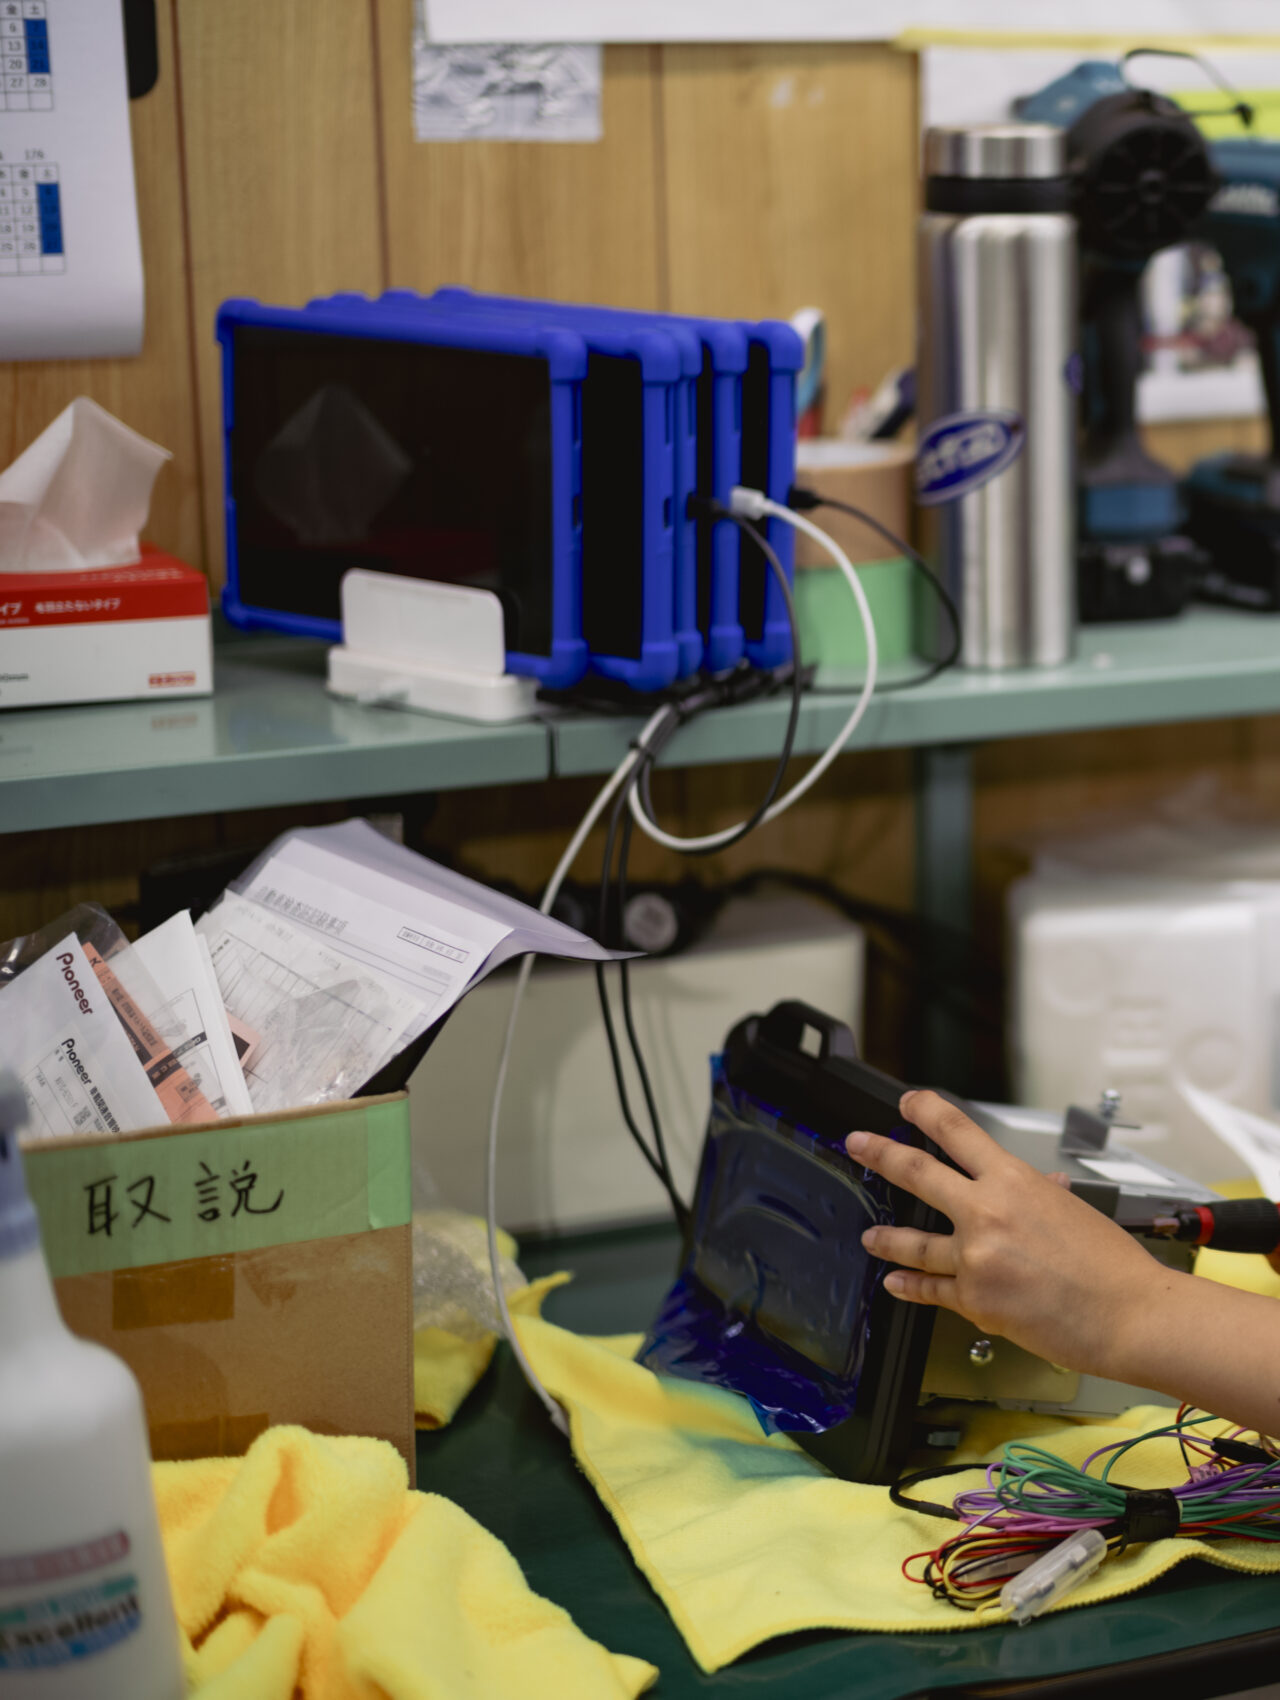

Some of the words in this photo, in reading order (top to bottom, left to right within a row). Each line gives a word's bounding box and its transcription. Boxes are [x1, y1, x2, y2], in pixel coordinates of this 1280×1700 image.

[8, 40, 21, 51] 13
[9, 59, 22, 70] 20
[10, 77, 23, 88] 27
[56, 952, 93, 1015] Pioneer
[61, 1038, 92, 1085] Pioneer
[84, 1160, 284, 1238] 取説
